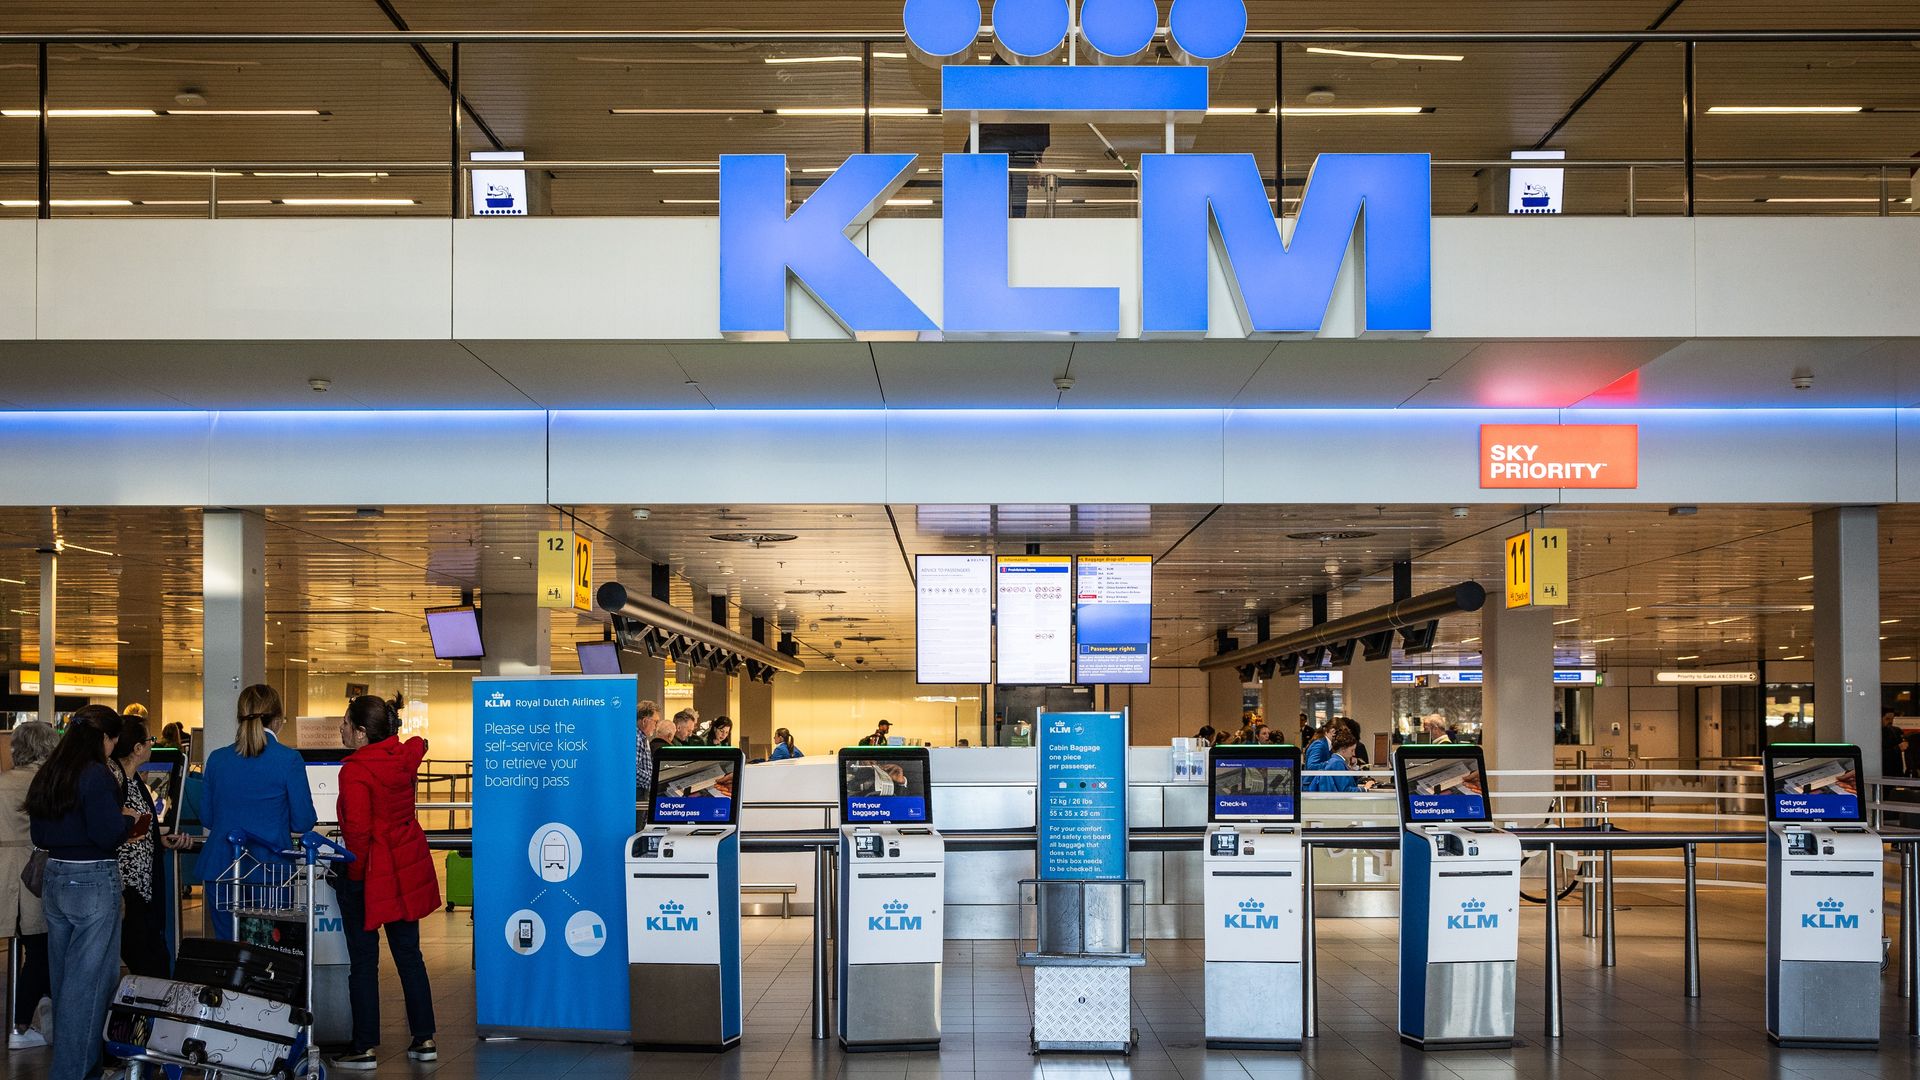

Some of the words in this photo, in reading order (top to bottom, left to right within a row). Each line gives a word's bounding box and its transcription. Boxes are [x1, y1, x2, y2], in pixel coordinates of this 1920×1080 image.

[719, 153, 1432, 334] KLM
[1490, 444, 1539, 461] SKY
[546, 538, 564, 551] 12
[1542, 536, 1557, 548] 11
[576, 542, 588, 588] 12
[1511, 538, 1526, 585] 11
[484, 699, 511, 707] KLM
[515, 698, 540, 709] Royal
[543, 698, 569, 707] Dutch
[572, 698, 606, 706] Airlines
[485, 722, 525, 734] Please
[530, 724, 550, 734] use
[555, 722, 576, 734] the
[485, 739, 553, 752] self-service
[557, 739, 588, 752] kiosk
[485, 758, 498, 769] to
[503, 757, 547, 769] retrieve
[551, 759, 578, 771] your
[485, 774, 539, 789] boarding
[543, 777, 570, 788] pass
[646, 917, 698, 931] KLM
[868, 916, 922, 930] KLM
[1224, 914, 1278, 929] KLM
[1448, 914, 1498, 929] KLM
[1802, 914, 1858, 928] KLM
[292, 948, 305, 956] Echo.
